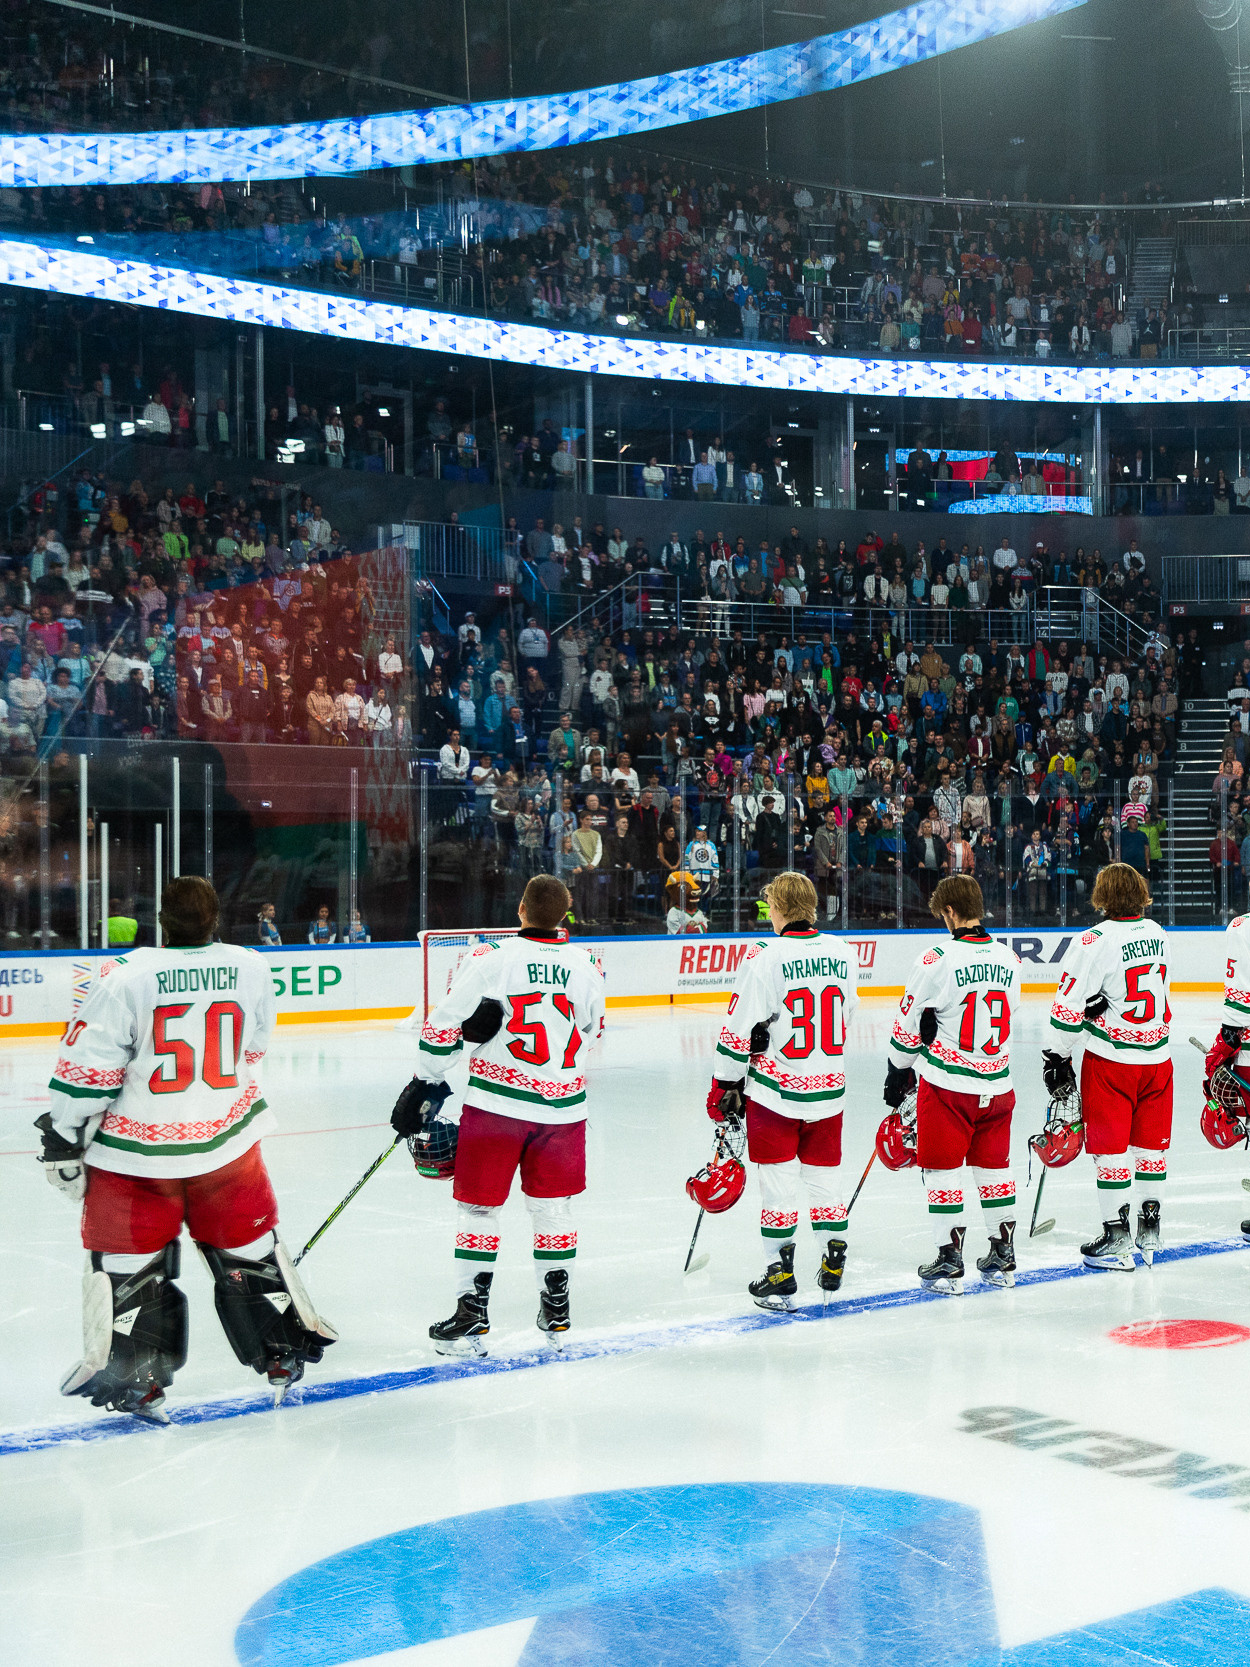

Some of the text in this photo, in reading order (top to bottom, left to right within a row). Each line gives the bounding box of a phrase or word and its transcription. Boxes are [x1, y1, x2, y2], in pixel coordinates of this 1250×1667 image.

[498, 585, 511, 595] P3
[1172, 606, 1185, 615] P3
[1183, 702, 1195, 711] 10
[1181, 722, 1188, 730] 9
[1180, 742, 1187, 751] 8
[1177, 763, 1184, 773] 7
[781, 956, 848, 982] AVRAMENKO
[954, 963, 1014, 988] GAZDEVICH
[156, 966, 239, 994] RUDOVICH
[677, 976, 723, 987] ОФИЦИАЛЬНЫЙ
[506, 991, 583, 1069] 57
[779, 984, 847, 1060] 30
[959, 989, 1011, 1056] 13
[148, 1000, 246, 1095] 50
